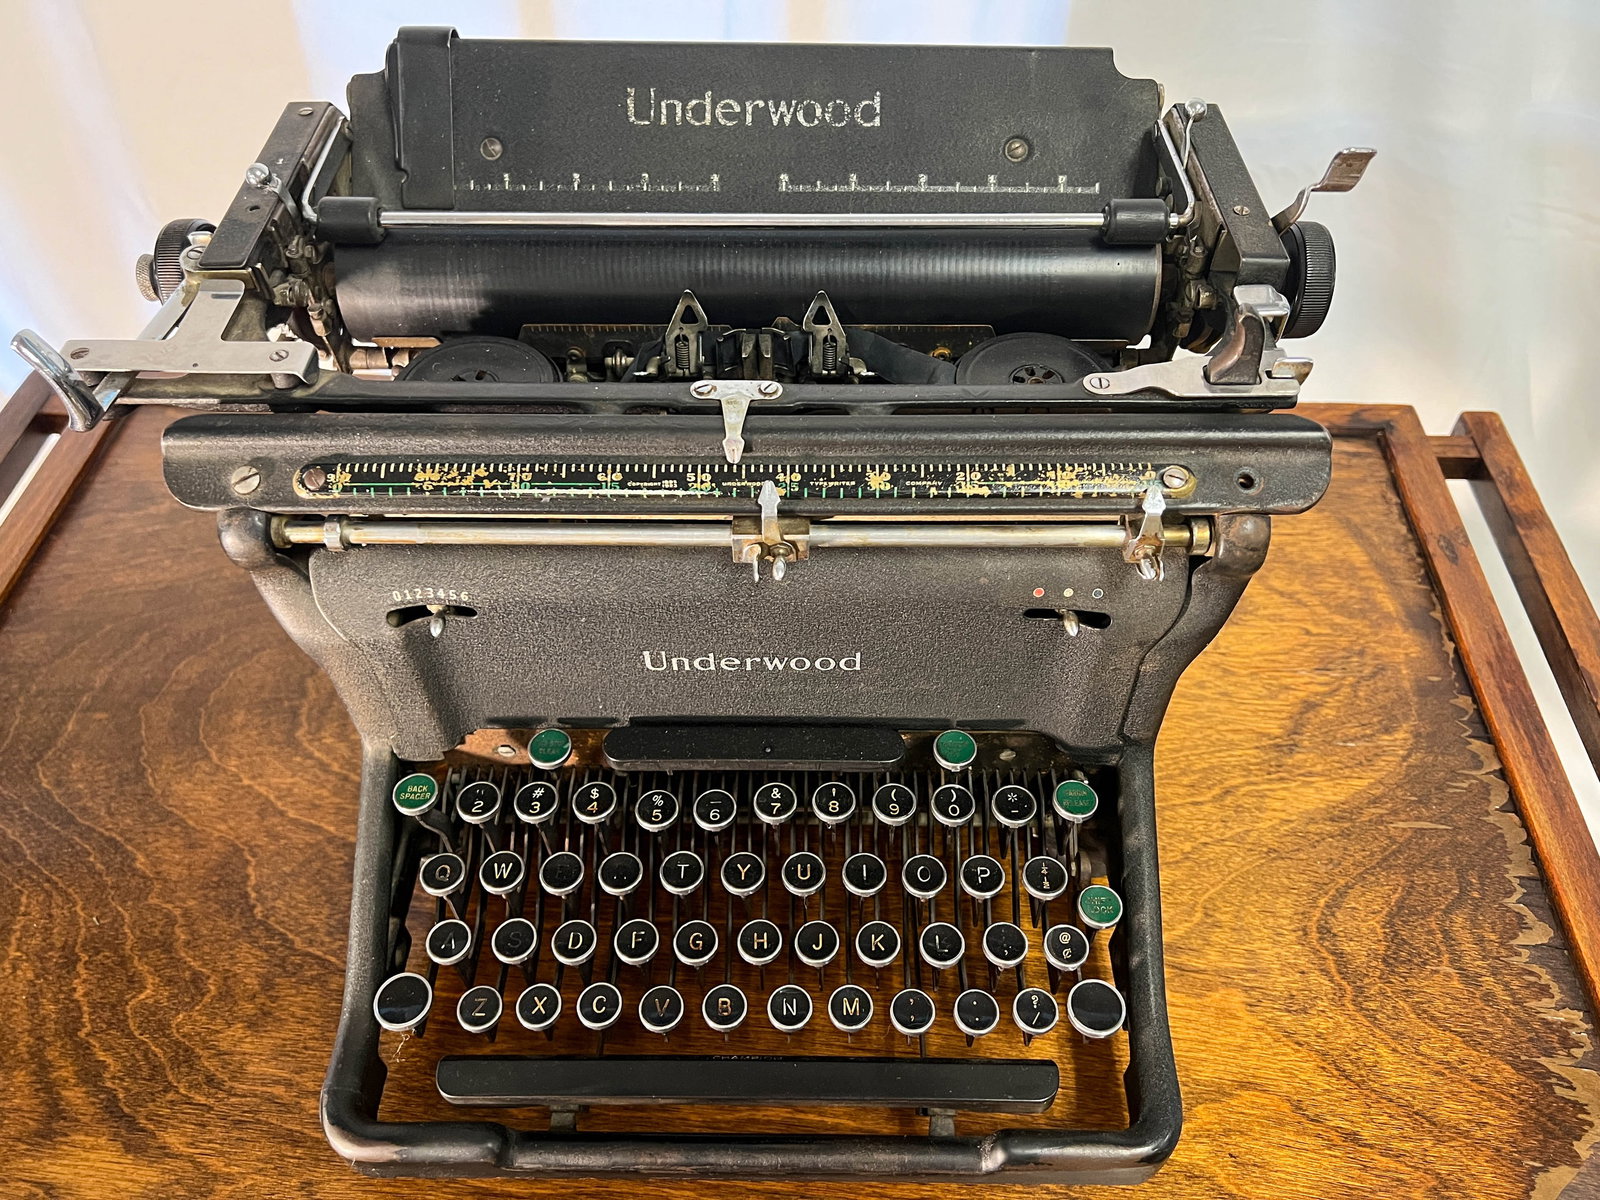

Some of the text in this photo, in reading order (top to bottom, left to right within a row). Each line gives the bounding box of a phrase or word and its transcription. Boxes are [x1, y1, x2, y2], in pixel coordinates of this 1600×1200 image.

[626, 87, 881, 127] Underwood
[686, 473, 712, 482] 50
[955, 472, 981, 481] 20
[642, 651, 862, 671] Underwood
[400, 792, 431, 800] SPACER
[532, 788, 545, 799] #
[590, 788, 599, 799] $
[653, 795, 663, 806] %
[770, 788, 782, 799] &
[472, 801, 483, 813] 2
[529, 802, 541, 814] 3
[587, 801, 599, 814] 4
[710, 809, 720, 820] 6
[770, 803, 781, 815] 7
[829, 801, 839, 812] 8
[889, 804, 900, 816] 9
[948, 805, 960, 817] 0
[651, 809, 662, 821] 5
[435, 865, 450, 881] Q
[493, 863, 513, 880] W
[677, 863, 689, 879] T
[737, 864, 751, 880] Y
[798, 864, 810, 880] U
[977, 867, 990, 883] P
[568, 932, 582, 949] D
[632, 931, 645, 948] F
[690, 933, 702, 950] G
[754, 932, 767, 949] H
[812, 933, 822, 950] J
[872, 934, 885, 951] K
[936, 935, 948, 952] L
[1059, 932, 1071, 944] @
[472, 998, 487, 1016] Z
[532, 997, 547, 1014] X
[593, 996, 606, 1013] C
[655, 999, 669, 1016] V
[719, 998, 731, 1015] B
[783, 998, 796, 1015] N
[843, 998, 859, 1015] M
